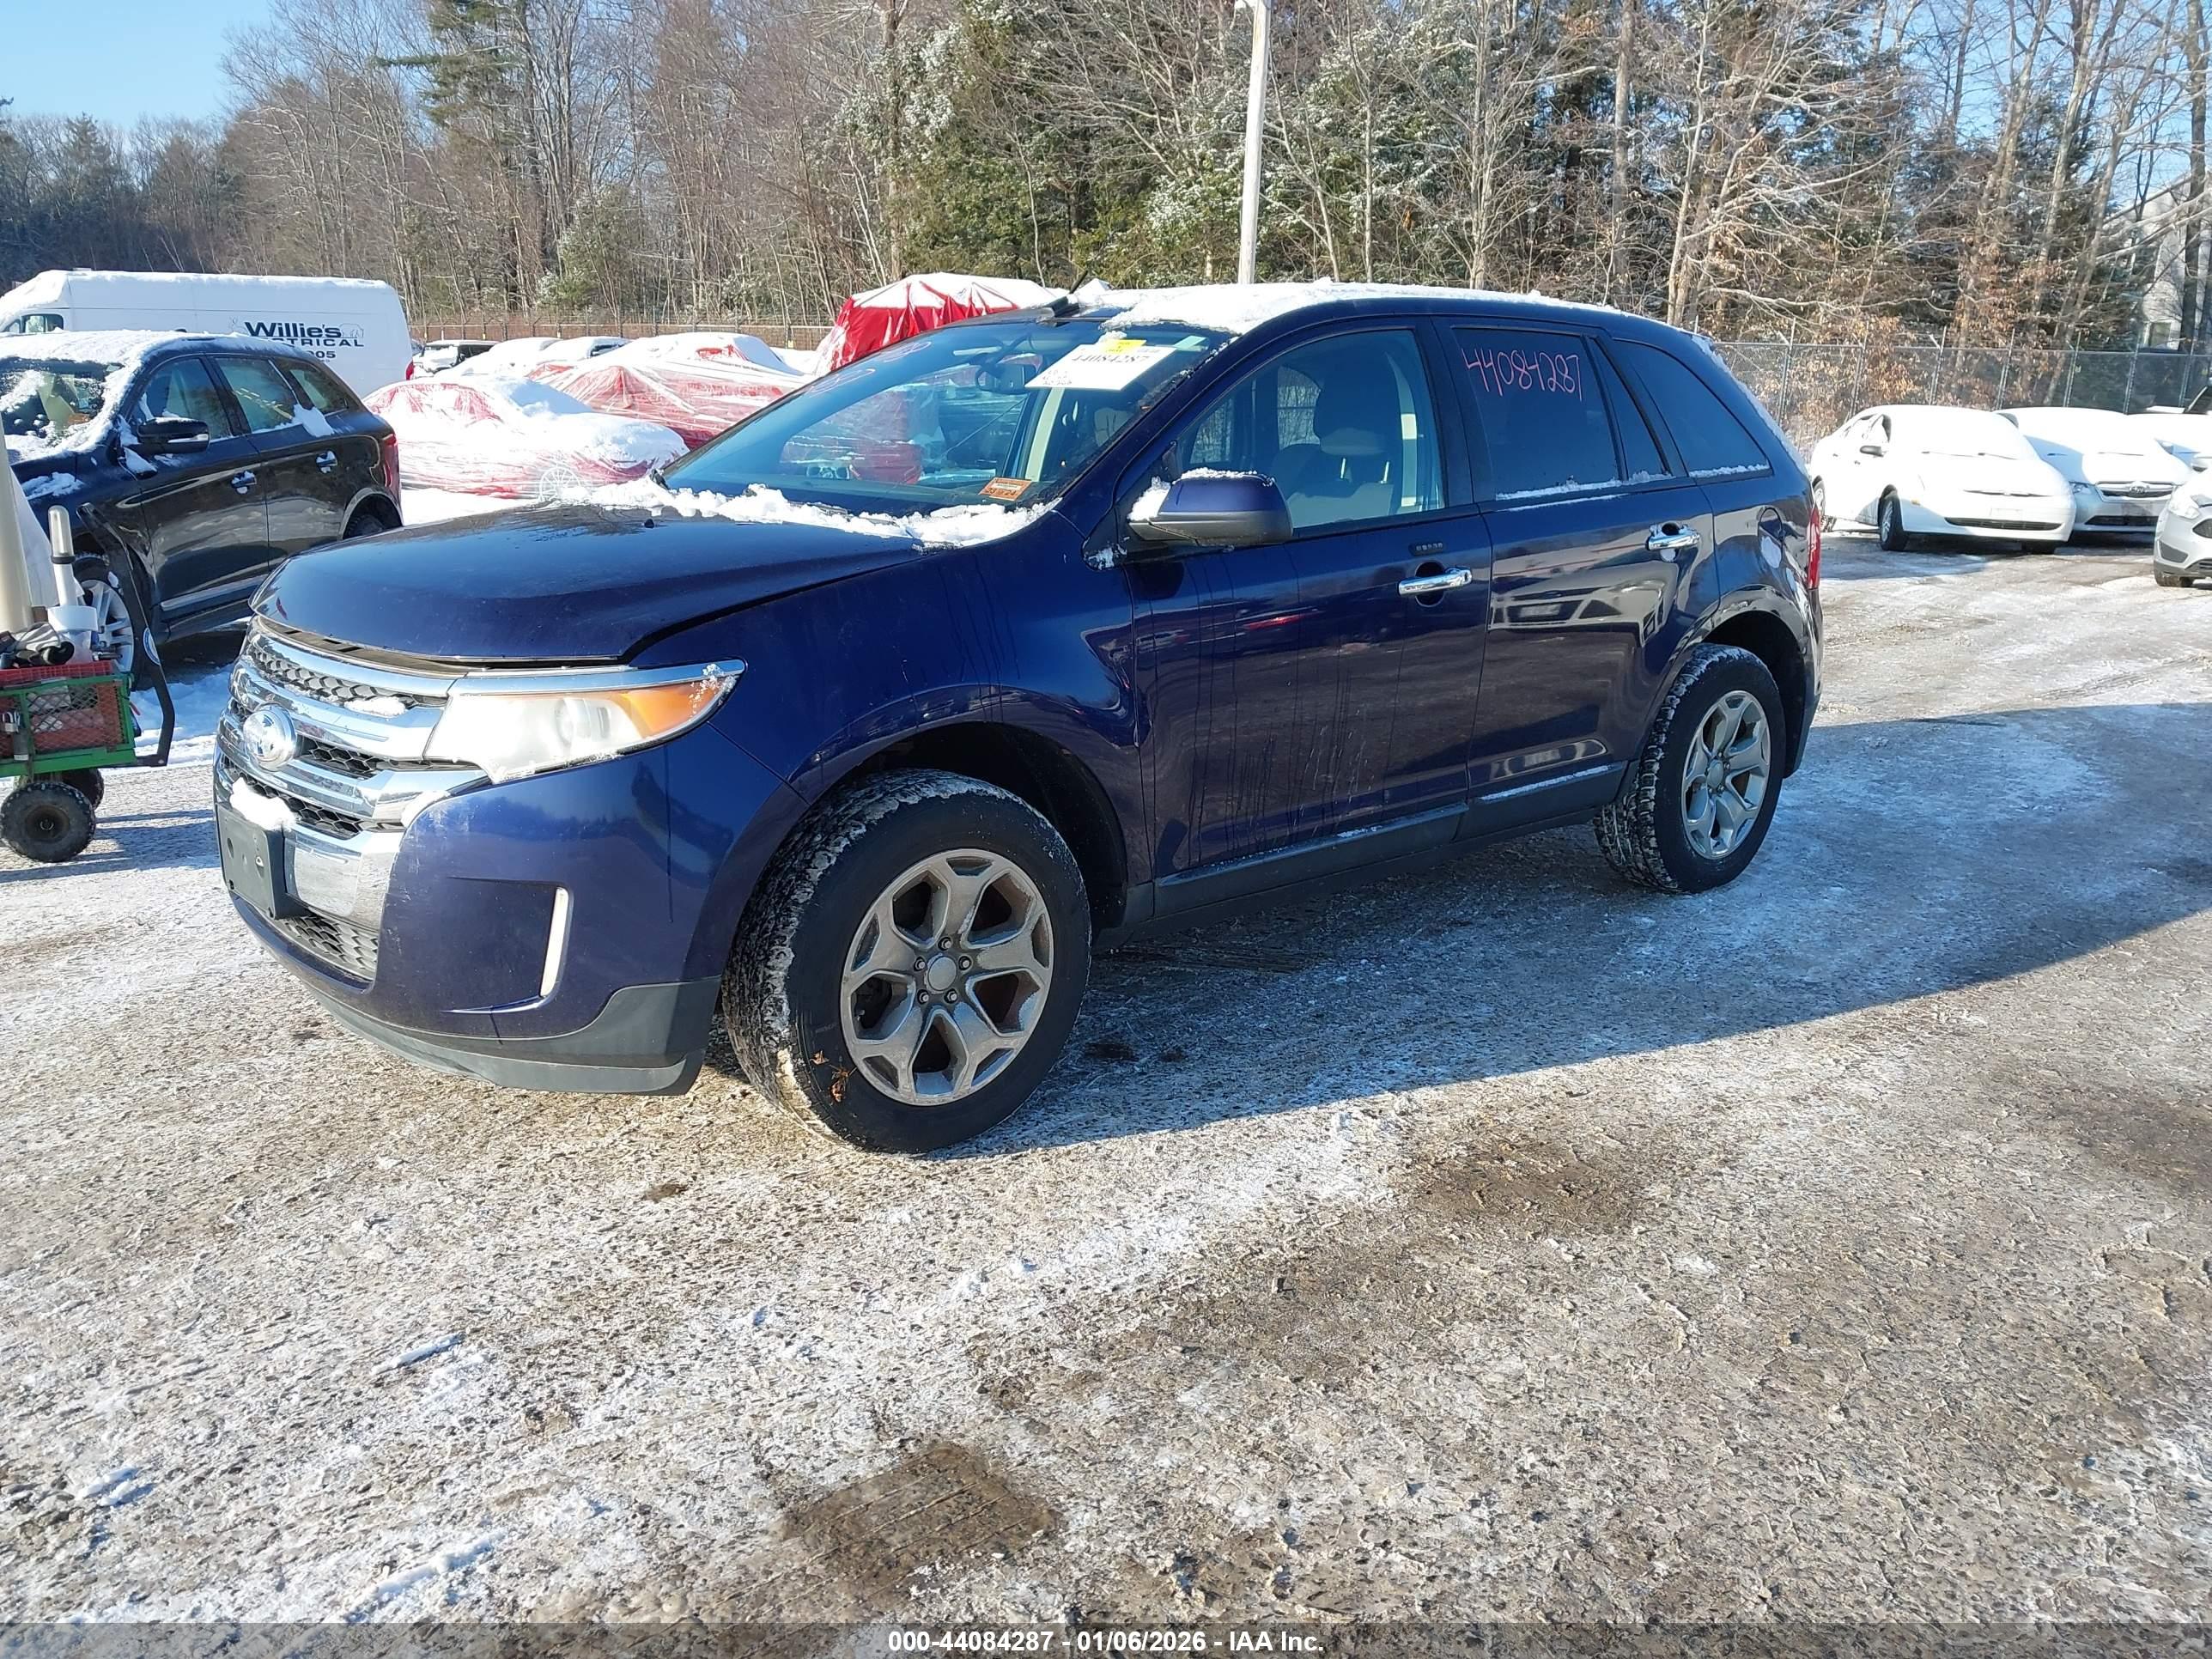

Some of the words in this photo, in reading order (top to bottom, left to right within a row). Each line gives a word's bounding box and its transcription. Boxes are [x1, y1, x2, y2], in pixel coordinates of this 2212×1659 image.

[244, 321, 342, 338] Willie's
[271, 337, 364, 347] TRICAL
[1461, 347, 1583, 402] 44084287
